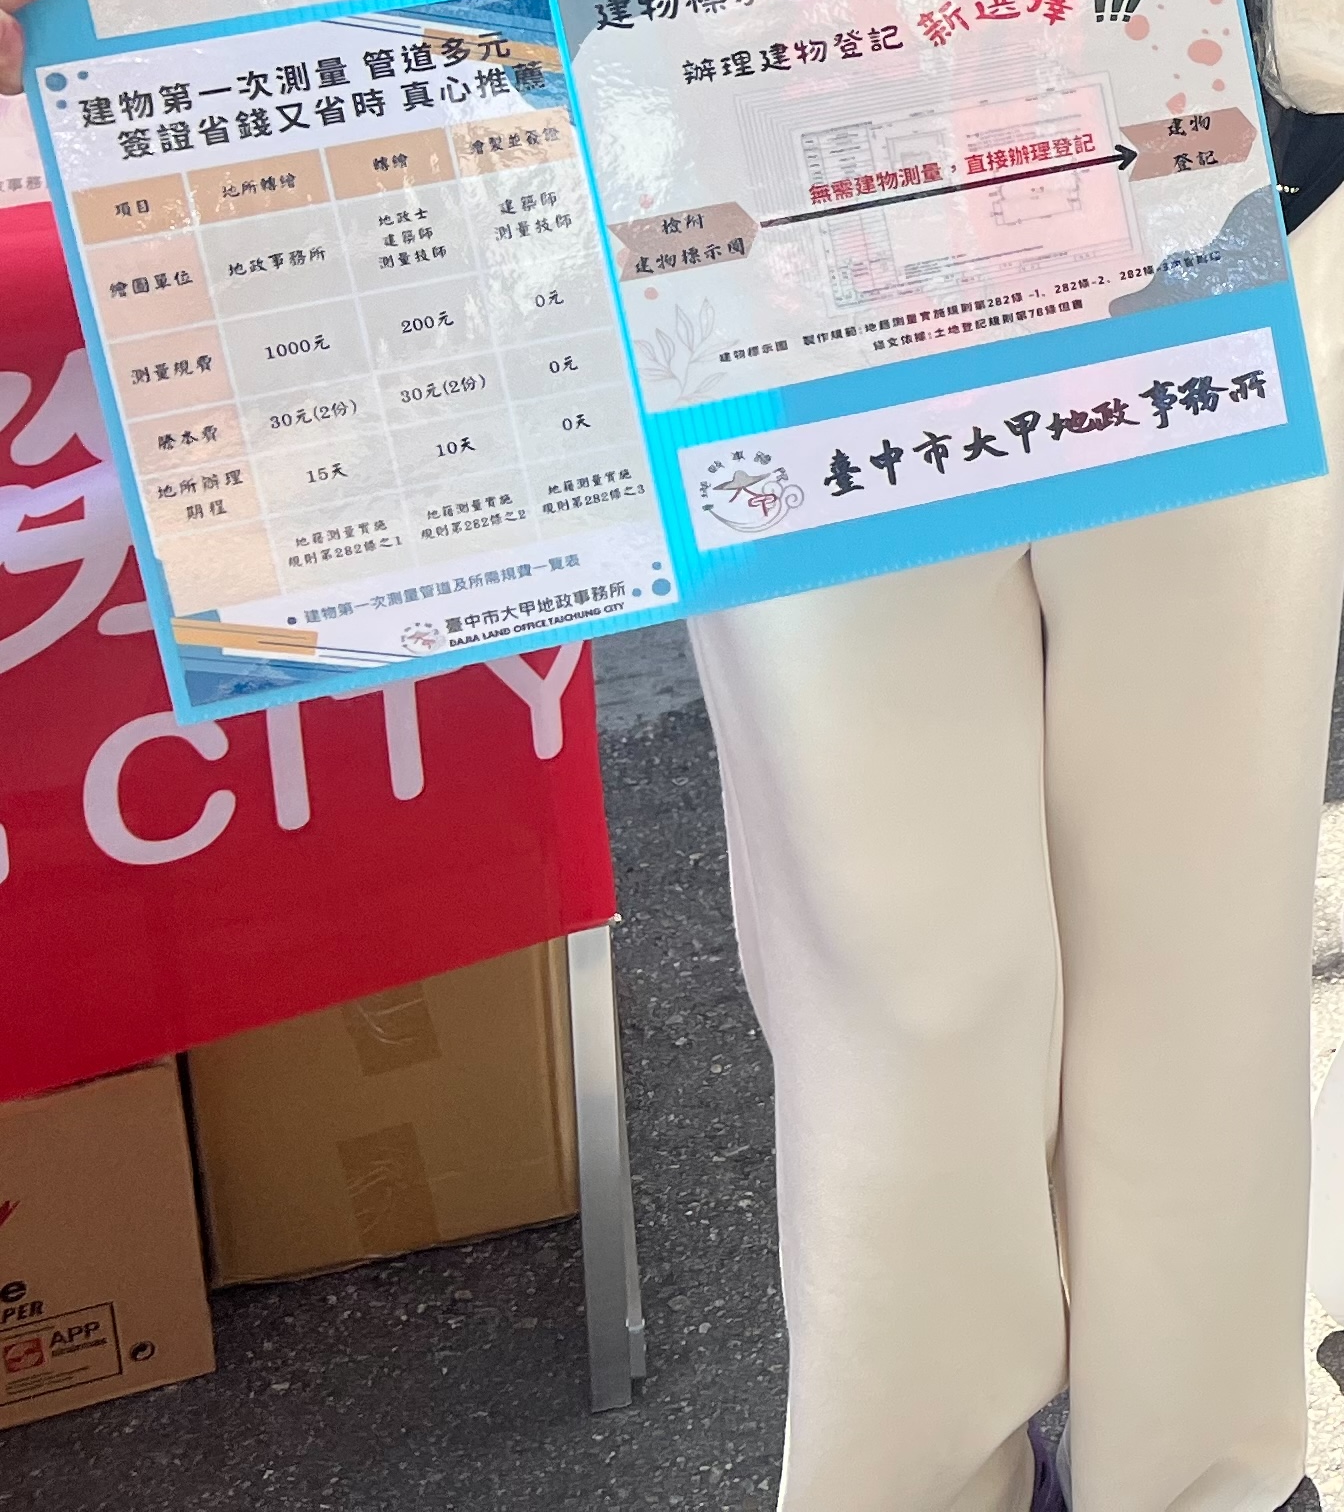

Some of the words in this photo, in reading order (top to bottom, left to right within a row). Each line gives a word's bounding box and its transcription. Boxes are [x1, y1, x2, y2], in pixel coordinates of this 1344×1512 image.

[679, 21, 906, 88] 辦理建物登記
[76, 55, 353, 129] 建物第一次測量
[360, 28, 513, 82] 管道多元
[115, 87, 389, 161] 簽證省錢又省時
[399, 60, 548, 112] 真心推薦
[1163, 109, 1215, 140] 建物
[372, 152, 410, 173] 轉繪
[806, 131, 1098, 207] 無需建物測量，直接辦理登記
[1170, 145, 1221, 174] 登記
[219, 171, 299, 200] 地所轉繪
[113, 197, 152, 218] 項目
[376, 205, 430, 229] 地政士
[381, 225, 435, 249] 建築師
[226, 244, 328, 278] 地政事務所
[377, 243, 449, 271] 測量技師
[632, 235, 747, 277] 建物標示圖
[108, 268, 195, 299] 繪圖單位
[533, 288, 565, 309] 0元
[399, 310, 455, 335] 200元
[263, 334, 331, 361] 1000元
[128, 354, 215, 386] 測量規費
[547, 354, 580, 376] 0元
[398, 371, 488, 406] 30元(2份)
[267, 396, 360, 432] 30元(2份)
[560, 412, 592, 434] 0天
[156, 424, 220, 452] 謄本費
[434, 435, 477, 459] 10天
[823, 370, 1268, 498] 臺中市大甲地政事務所
[154, 468, 245, 501] 地所辦理
[305, 461, 349, 486] 15天
[184, 498, 229, 522] 期程
[302, 551, 582, 626] 建物第一次測量管道及所需規費一覽表
[443, 579, 627, 635] 臺中市大甲地政事務所
[50, 1320, 101, 1348] APP
